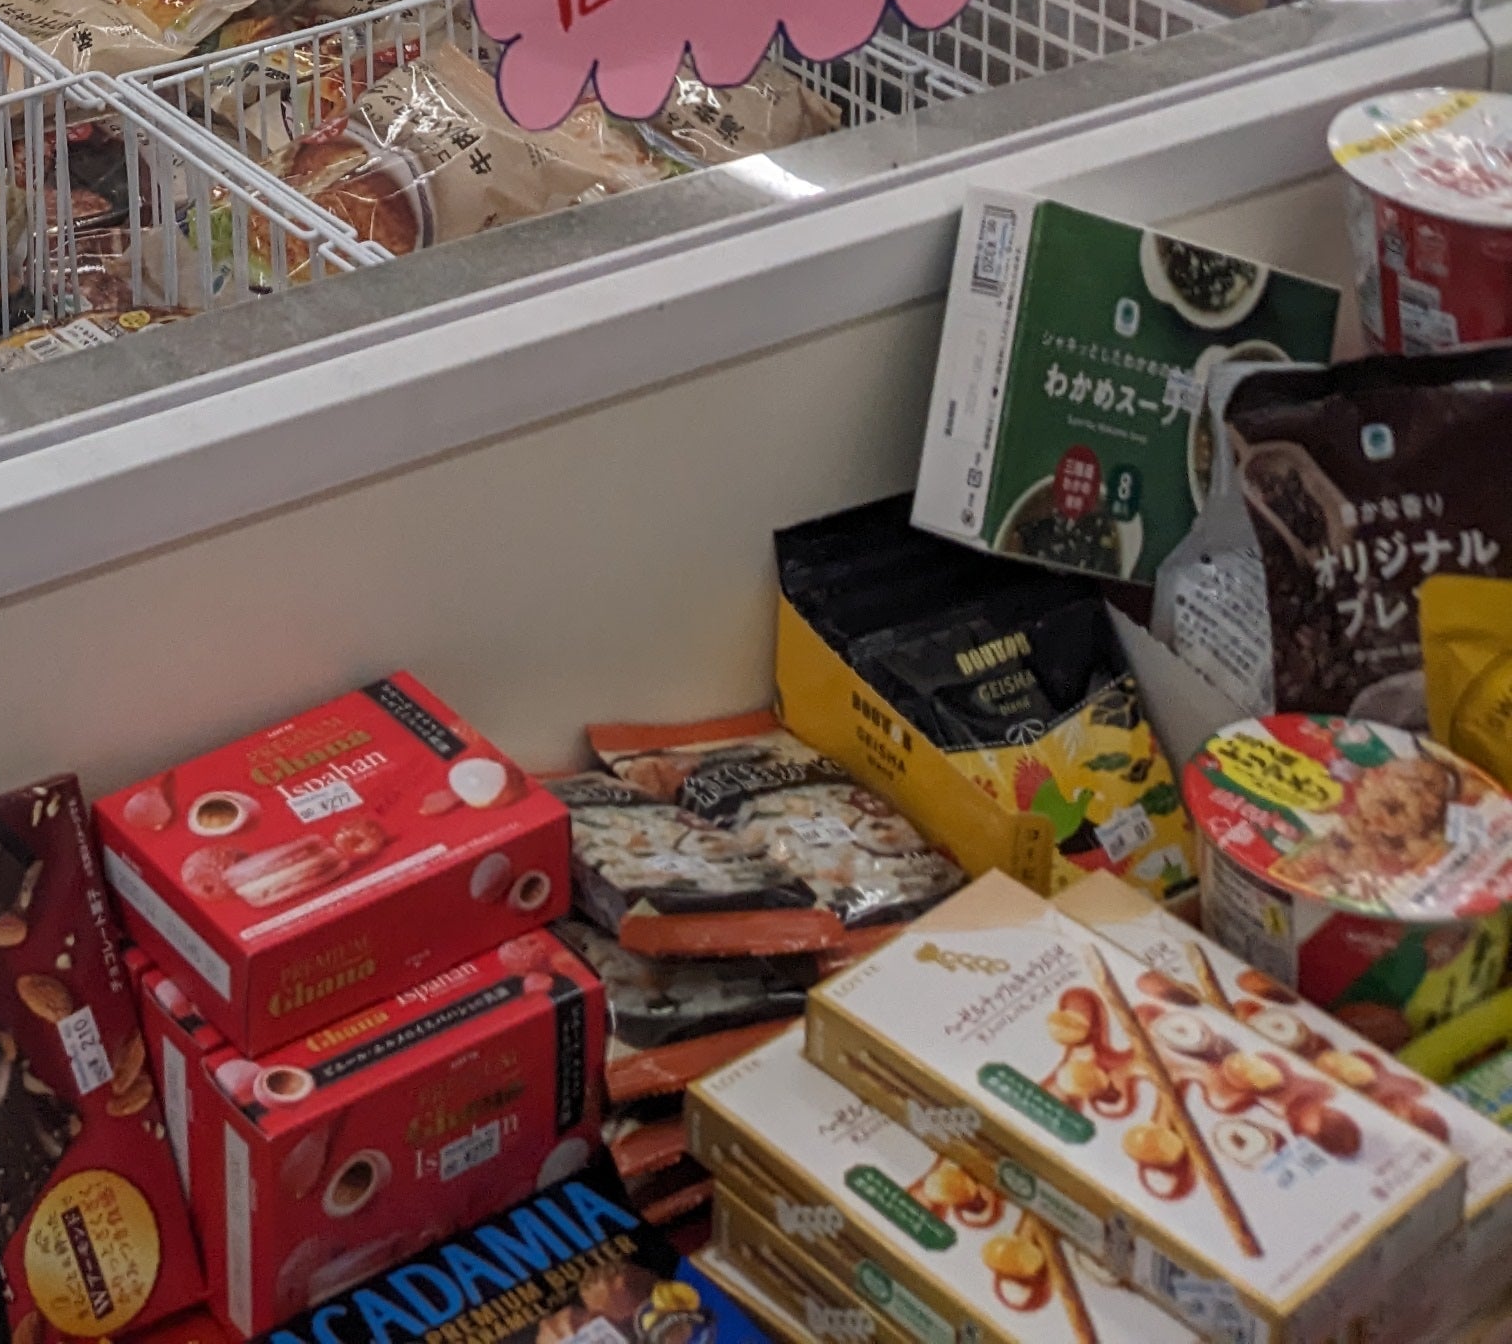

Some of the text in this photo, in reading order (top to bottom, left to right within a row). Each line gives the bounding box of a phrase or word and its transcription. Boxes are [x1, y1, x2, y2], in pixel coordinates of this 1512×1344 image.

[1313, 528, 1501, 591] オリジナル
[976, 668, 1037, 704] GEISHA
[270, 1180, 640, 1344] CADAMIA
[543, 1233, 640, 1290] BUTTER
